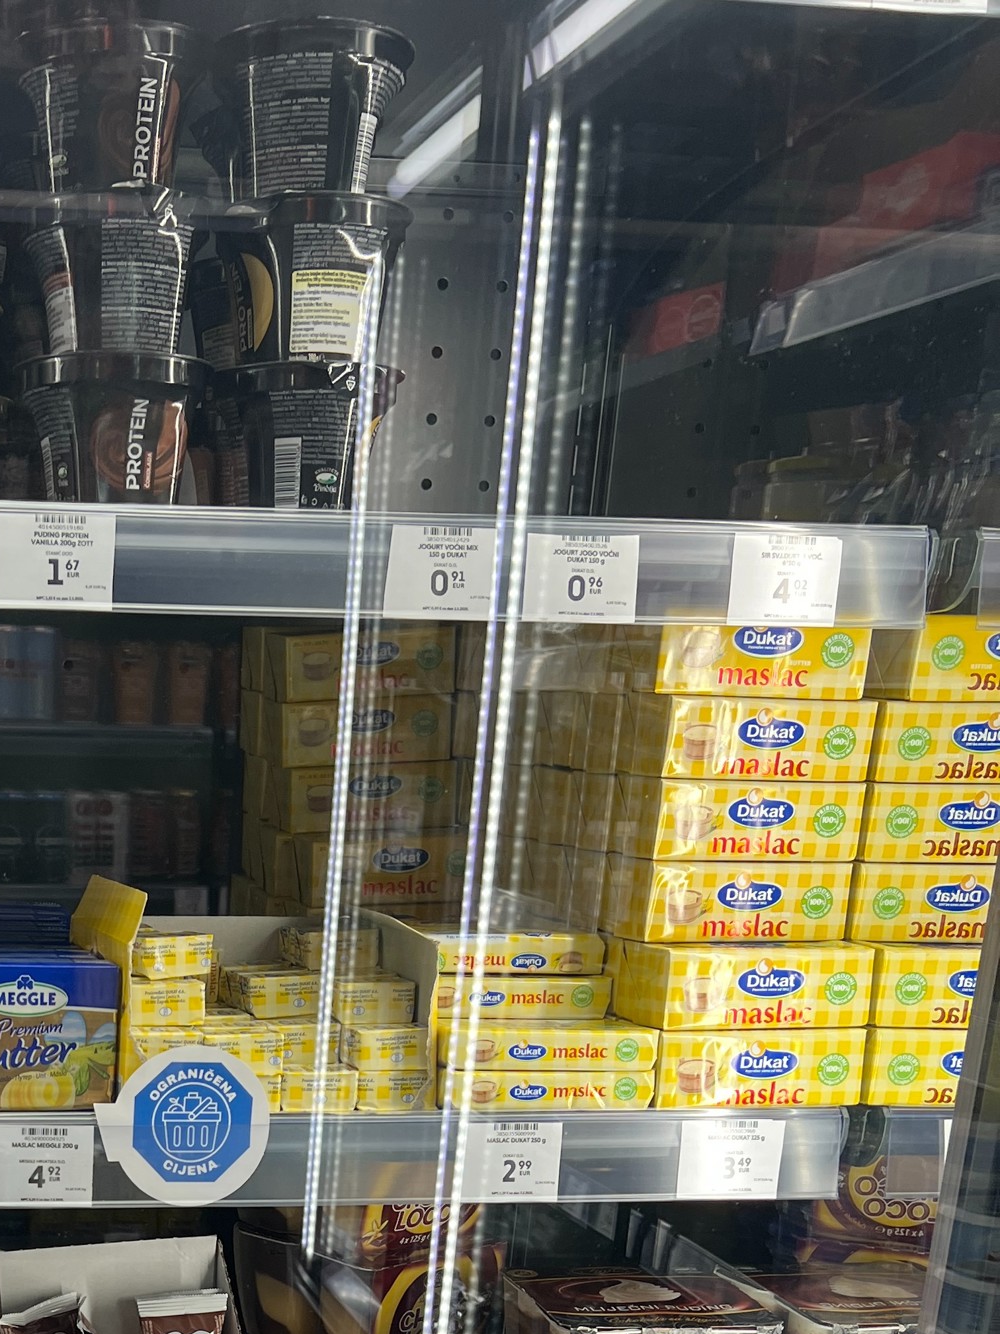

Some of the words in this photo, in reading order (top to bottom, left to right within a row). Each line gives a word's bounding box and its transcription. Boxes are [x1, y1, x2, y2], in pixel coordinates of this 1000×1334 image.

[125, 399, 150, 491] PROTEIN
[30, 539, 59, 547] VANILLA
[34, 531, 57, 540] PUDING
[59, 532, 89, 540] PROTEIN
[418, 543, 441, 551] JOGURT
[464, 543, 478, 551] MIX
[447, 551, 467, 559] DUKAT
[553, 549, 576, 557] JOGURT
[47, 558, 64, 585] 1
[65, 560, 80, 571] 67
[431, 569, 448, 597] 0
[452, 571, 466, 581] 91
[588, 577, 603, 588] 96
[743, 630, 793, 647] Dukat
[717, 667, 809, 689] maslac
[719, 753, 809, 778] maslac
[737, 803, 786, 820] Dukat
[711, 834, 800, 856] maslac
[725, 886, 775, 902] Dukat
[702, 915, 789, 938] maslac
[723, 1001, 812, 1025] maslac
[510, 1045, 544, 1058] Dukat
[148, 1068, 237, 1104] OGRANIČENA
[162, 1158, 218, 1177] CIJENA
[738, 1157, 752, 1167] 49
[28, 1165, 45, 1188] 4
[48, 1166, 61, 1176] 92
